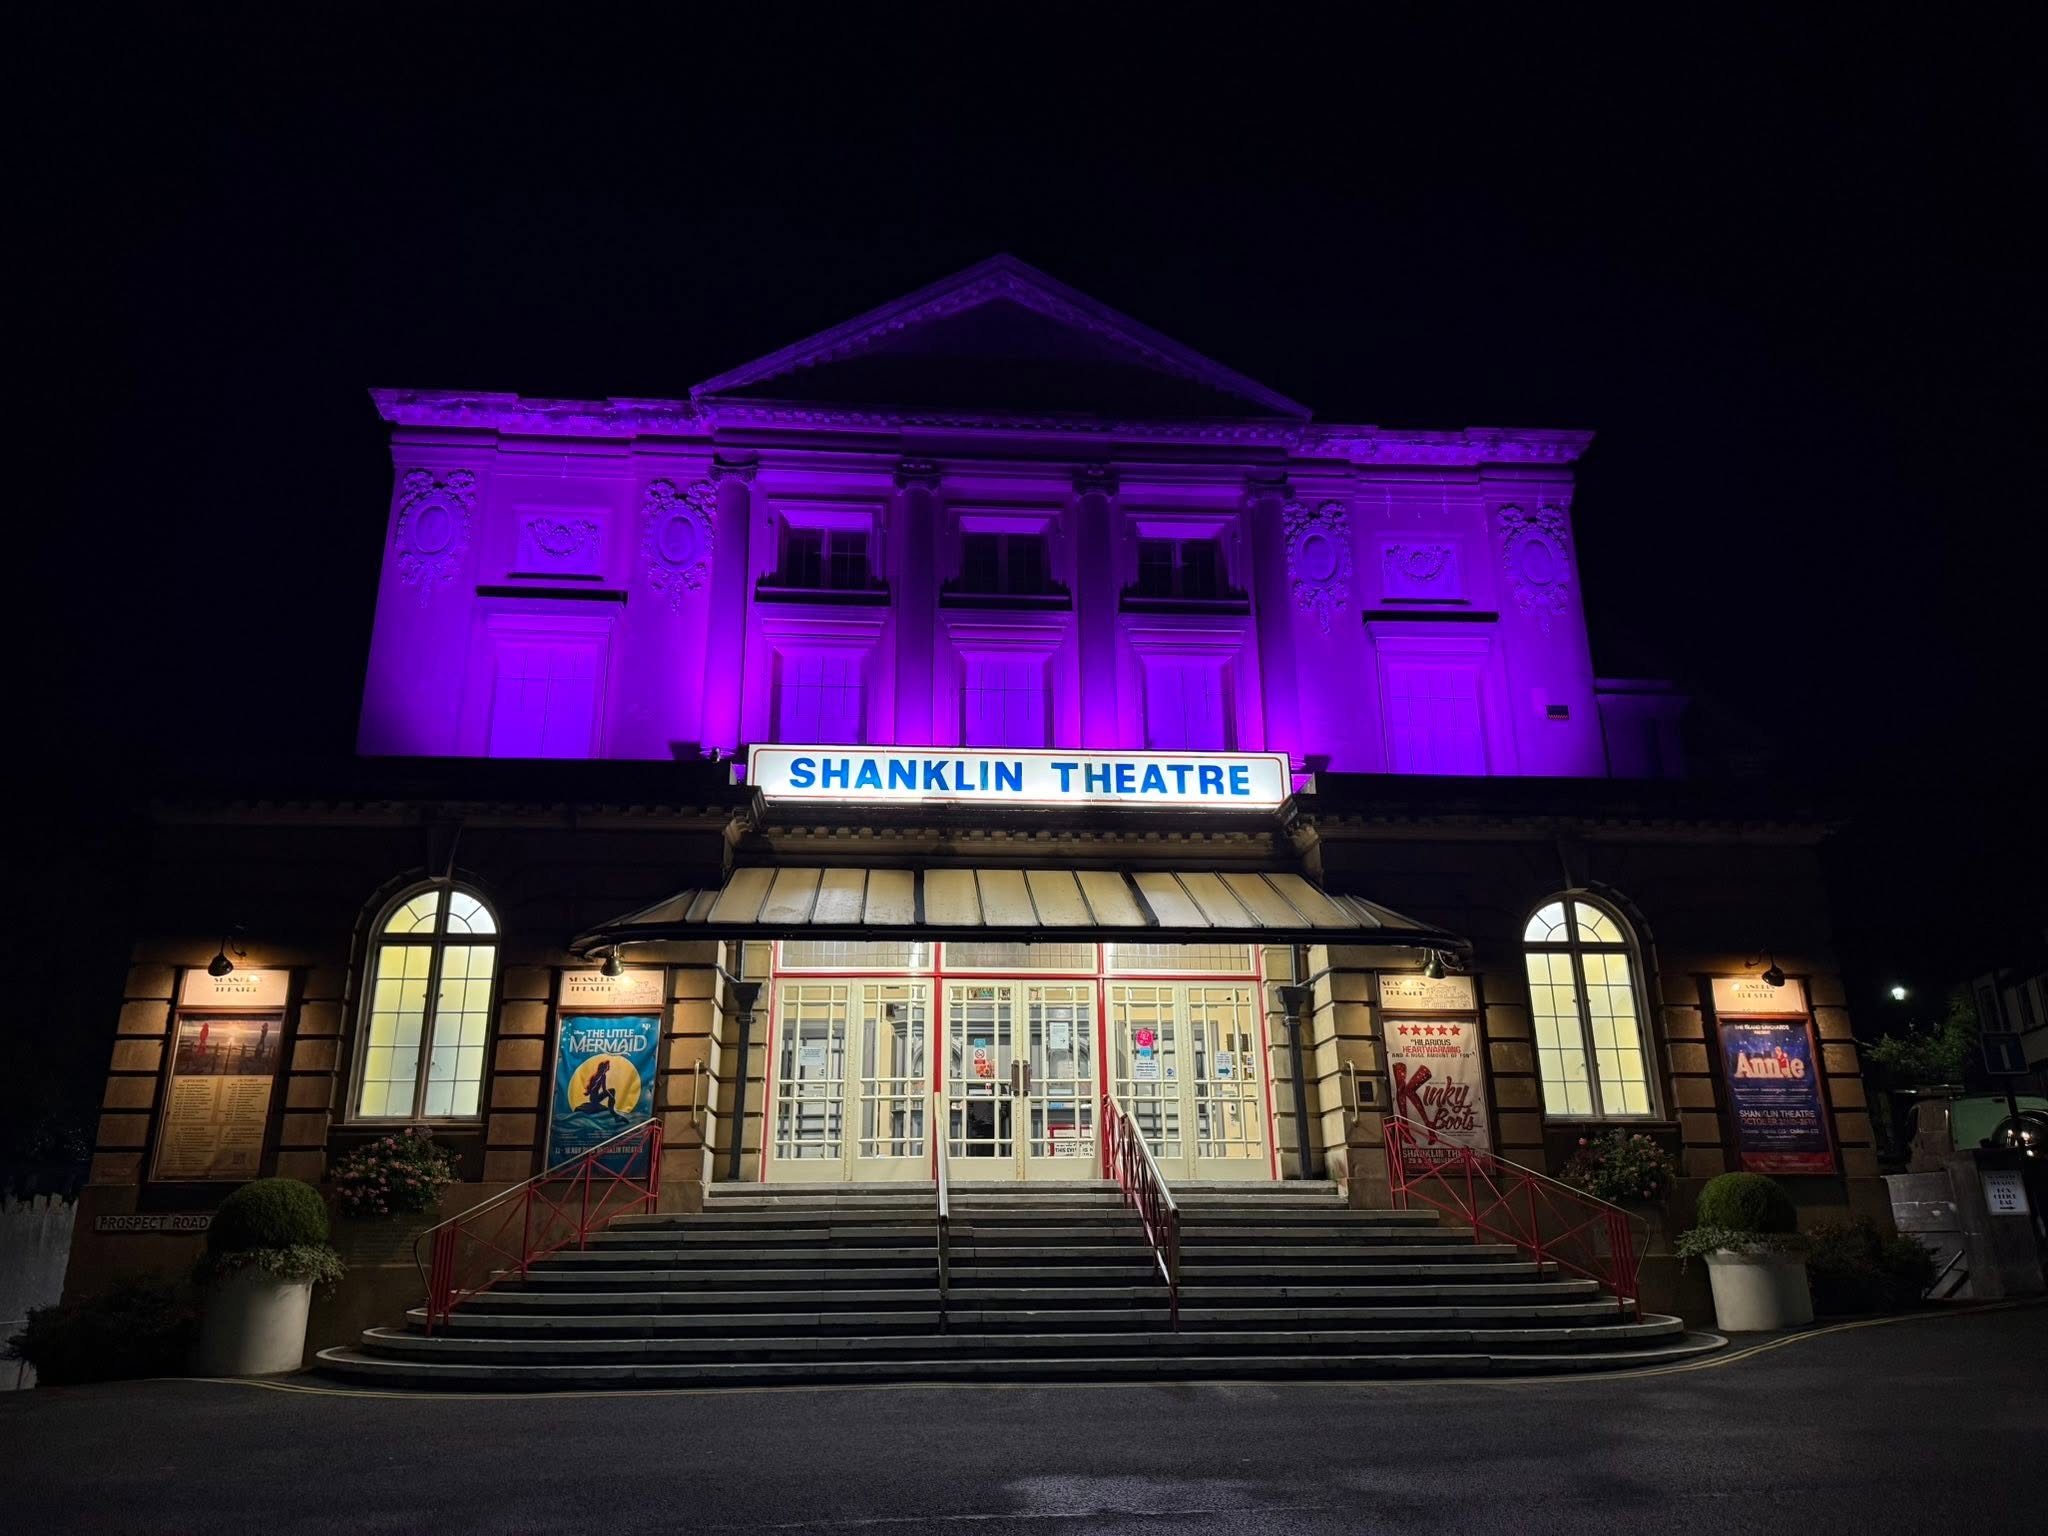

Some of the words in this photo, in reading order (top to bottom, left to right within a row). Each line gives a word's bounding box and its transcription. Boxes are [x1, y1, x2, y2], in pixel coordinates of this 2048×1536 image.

[788, 757, 1023, 792] SHANKLIN
[1051, 762, 1251, 796] THEATRE
[568, 1034, 648, 1057] MERMAID
[586, 1028, 605, 1039] THE
[606, 1028, 635, 1039] LITTLE
[1734, 1046, 1805, 1079] Annie
[1392, 1062, 1473, 1146] Kinky
[1434, 1107, 1483, 1131] Boots
[99, 1216, 167, 1230] PROSPECT
[172, 1216, 209, 1229] ROAD
